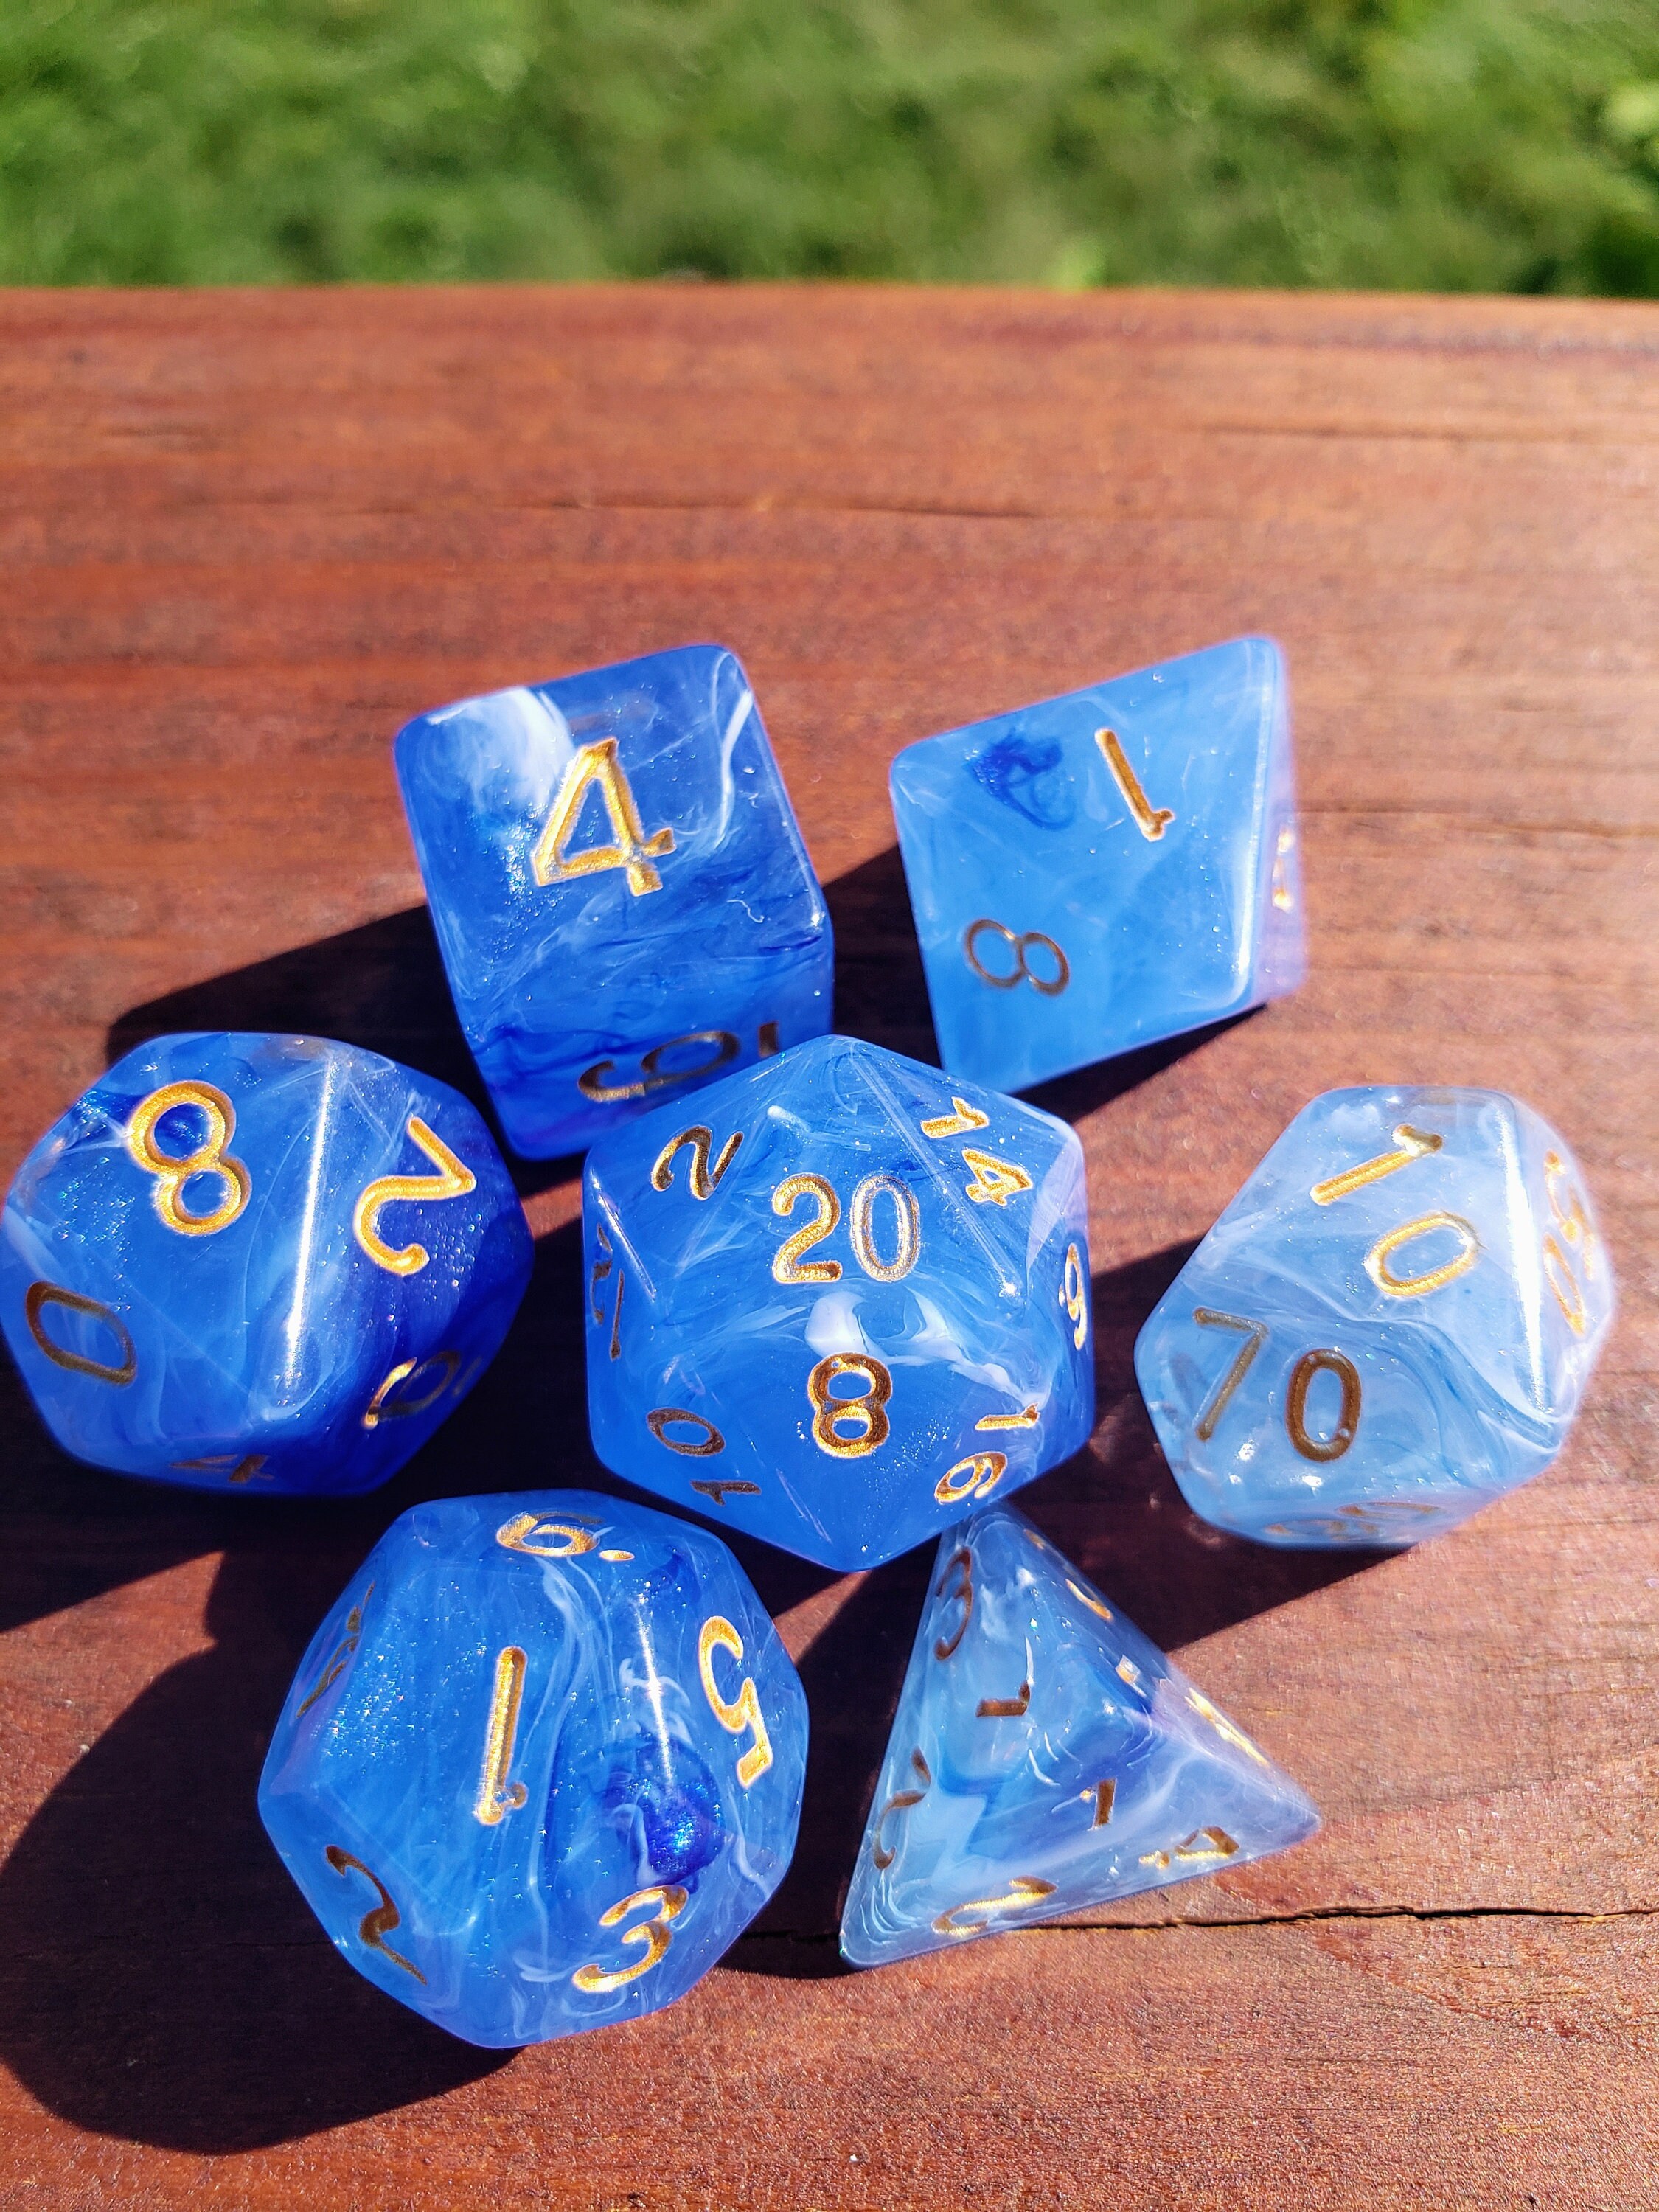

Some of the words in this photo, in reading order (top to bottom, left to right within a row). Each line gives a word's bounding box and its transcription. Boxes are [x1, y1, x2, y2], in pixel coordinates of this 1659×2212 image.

[532, 737, 676, 897] 4
[1094, 728, 1175, 842] 1
[964, 919, 1070, 997] 8
[127, 1080, 251, 1236] 8
[354, 1115, 476, 1276] 2
[650, 1125, 745, 1201] 2
[920, 1096, 1032, 1206] 14
[771, 1172, 922, 1284] 20
[1309, 1124, 1482, 1298] 10
[24, 1280, 138, 1388] 0
[1192, 1306, 1362, 1462] 70
[646, 1407, 762, 1506] 10
[807, 1352, 893, 1458] 8
[934, 1403, 1040, 1504] 16
[473, 1645, 528, 1826] 1
[698, 1615, 773, 1789] 5
[325, 1845, 428, 1986] 2
[572, 1884, 689, 1993] 3
